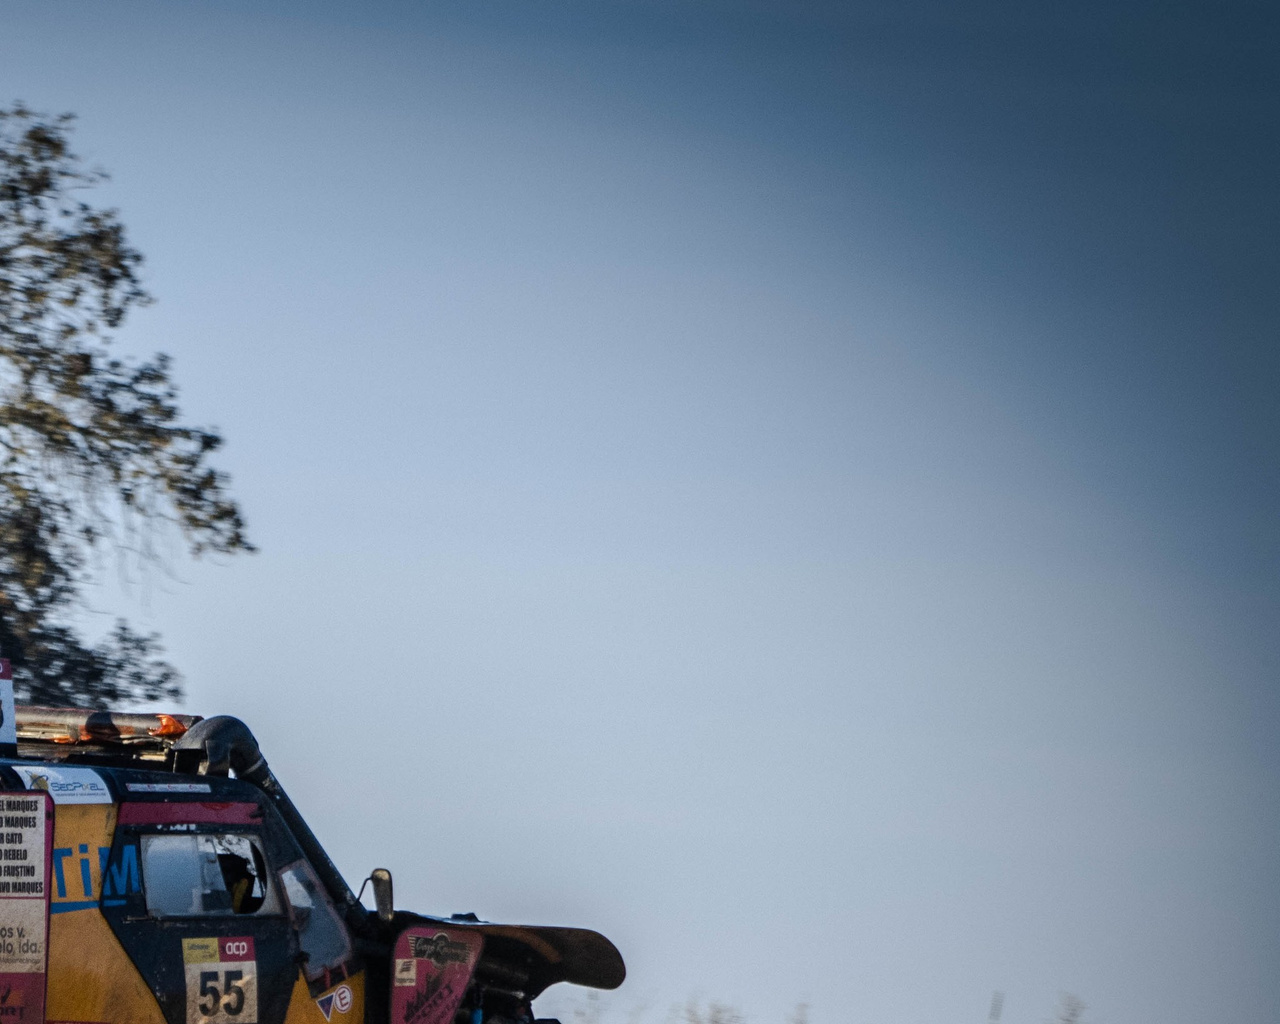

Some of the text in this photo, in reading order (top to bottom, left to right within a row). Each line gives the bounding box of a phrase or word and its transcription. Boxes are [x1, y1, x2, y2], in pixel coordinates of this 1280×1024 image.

[6, 799, 38, 813] MARQUES
[4, 816, 37, 829] MARQUES
[5, 832, 23, 845] GATO
[4, 848, 28, 861] REBELO
[3, 865, 35, 877] FAUSTINO
[11, 881, 43, 895] MARQUES
[225, 941, 248, 956] acp
[198, 970, 245, 1016] 55
[338, 988, 349, 1009] E
